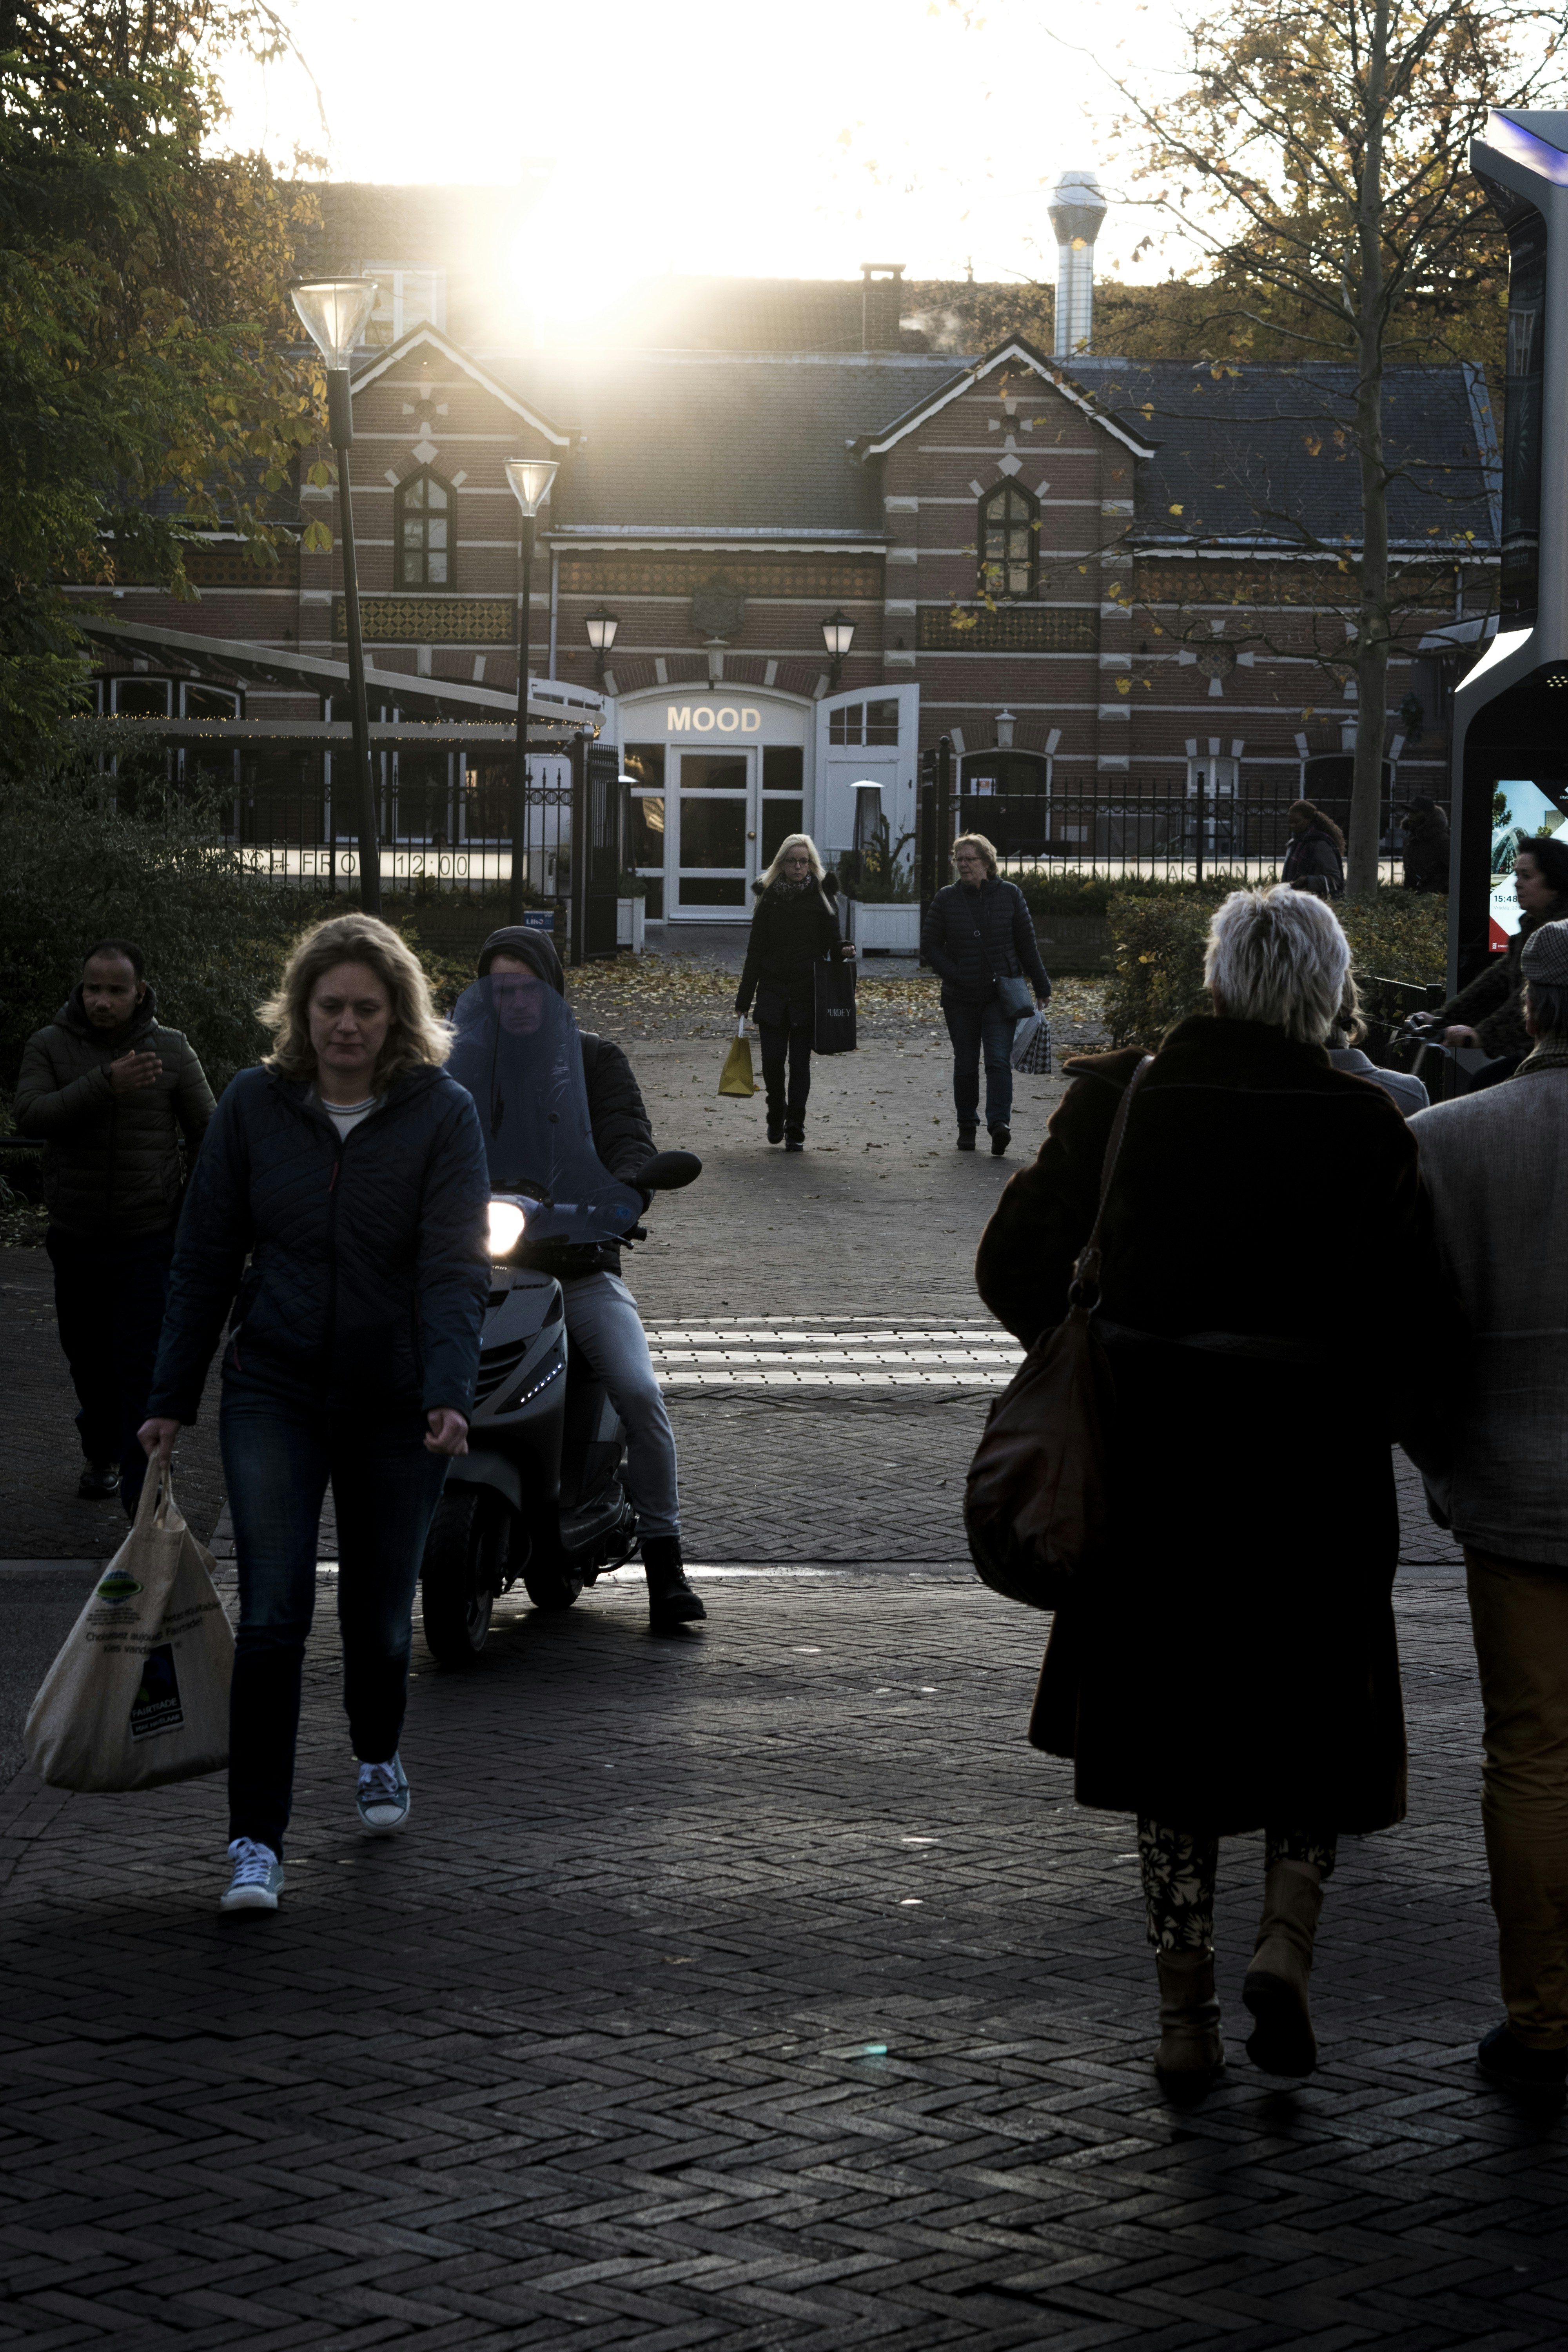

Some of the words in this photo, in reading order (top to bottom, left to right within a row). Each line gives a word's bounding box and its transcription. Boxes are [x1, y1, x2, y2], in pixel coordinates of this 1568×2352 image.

[667, 707, 761, 732] MOOD
[303, 853, 356, 873] FRO
[397, 855, 467, 876] 12:00
